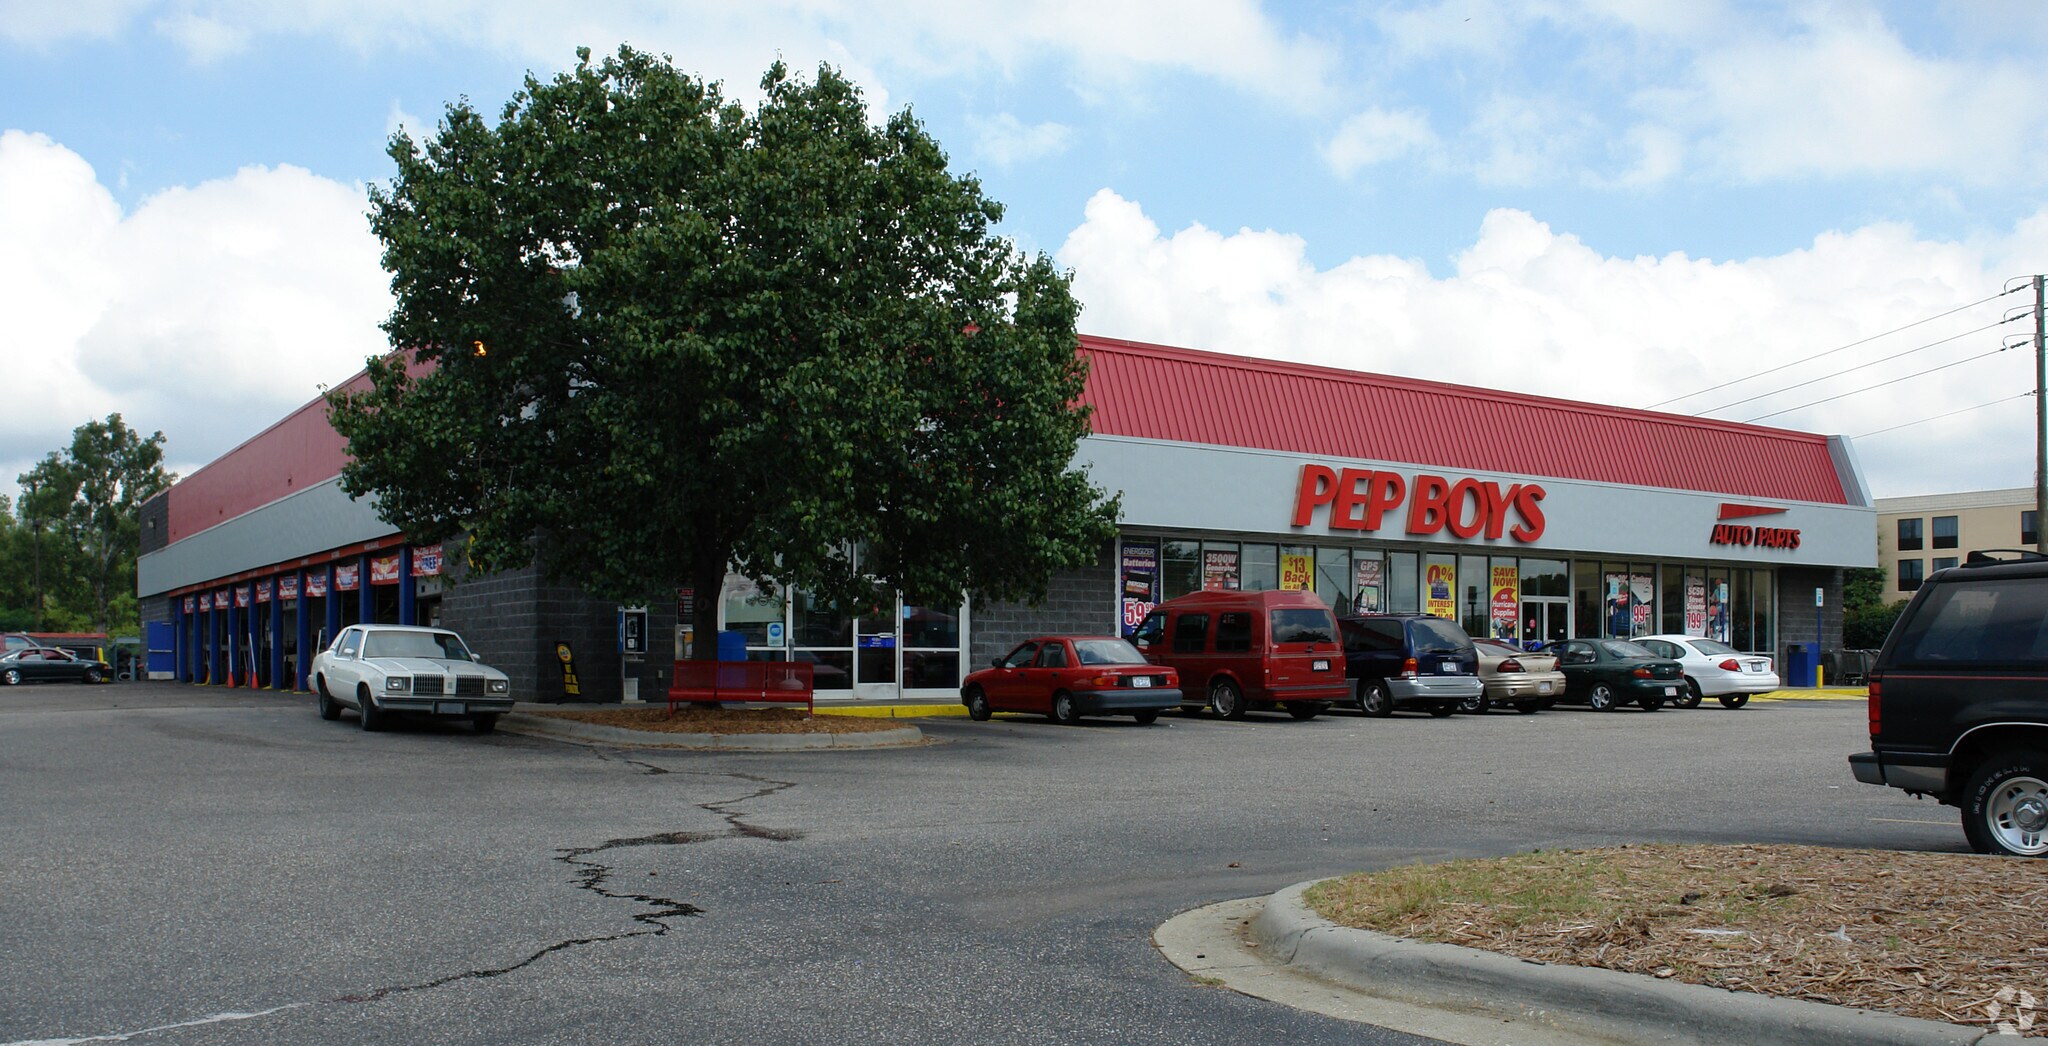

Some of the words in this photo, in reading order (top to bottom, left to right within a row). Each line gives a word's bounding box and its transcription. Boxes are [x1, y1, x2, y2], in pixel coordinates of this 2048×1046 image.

[1291, 464, 1406, 531] PEP
[1405, 474, 1547, 543] BOYS
[1709, 524, 1753, 546] AUTO
[1754, 527, 1801, 549] PARTS
[1123, 547, 1155, 555] ENERGIZER
[1122, 558, 1156, 568] Batteries
[1206, 553, 1237, 564] 3500W
[1360, 560, 1379, 572] GPS
[1283, 570, 1311, 584] Back
[1493, 567, 1516, 577] SAVE
[1493, 577, 1517, 587] NOW!
[1428, 600, 1454, 608] INTEREST
[1493, 600, 1517, 608] Hurricane
[1493, 608, 1516, 617] Supplies
